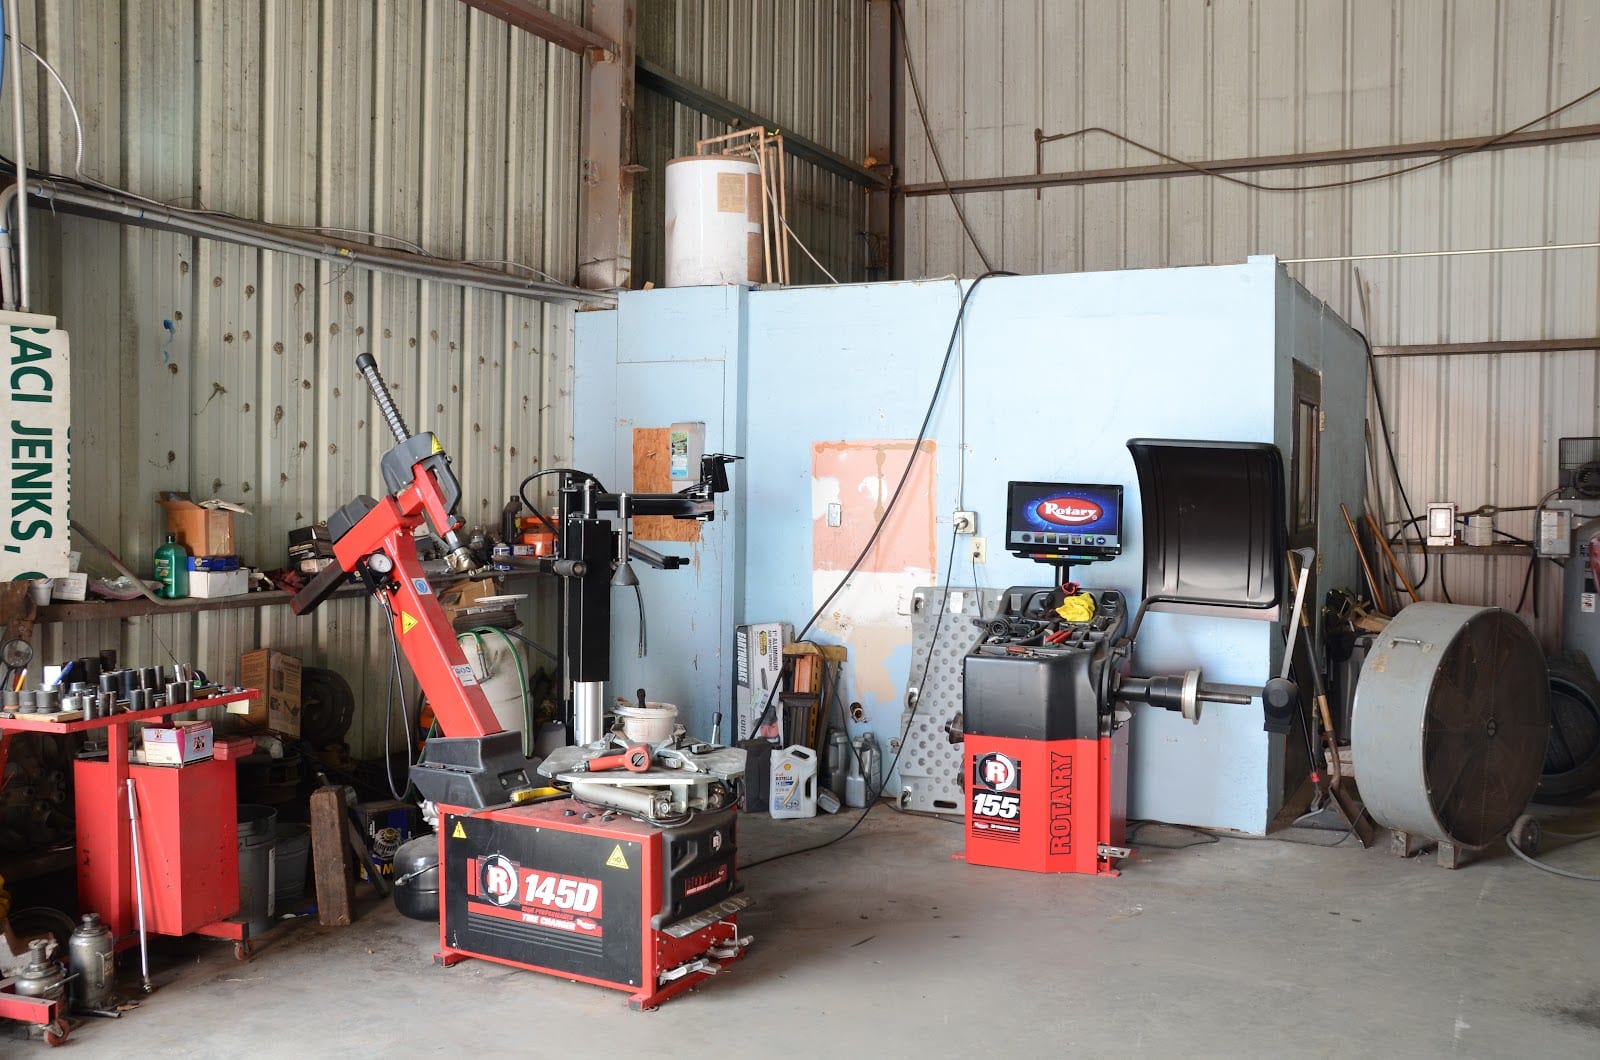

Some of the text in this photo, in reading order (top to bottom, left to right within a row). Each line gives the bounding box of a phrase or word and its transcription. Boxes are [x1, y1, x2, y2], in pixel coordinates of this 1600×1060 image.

[4, 420, 52, 554] JENKS,
[1044, 502, 1097, 521] Rotary
[737, 631, 748, 683] EARTHQUAKE
[974, 793, 1019, 818] 155
[1050, 751, 1073, 856] ROTARY
[525, 874, 599, 913] 145D
[522, 913, 576, 931] TIRE CHANGER
